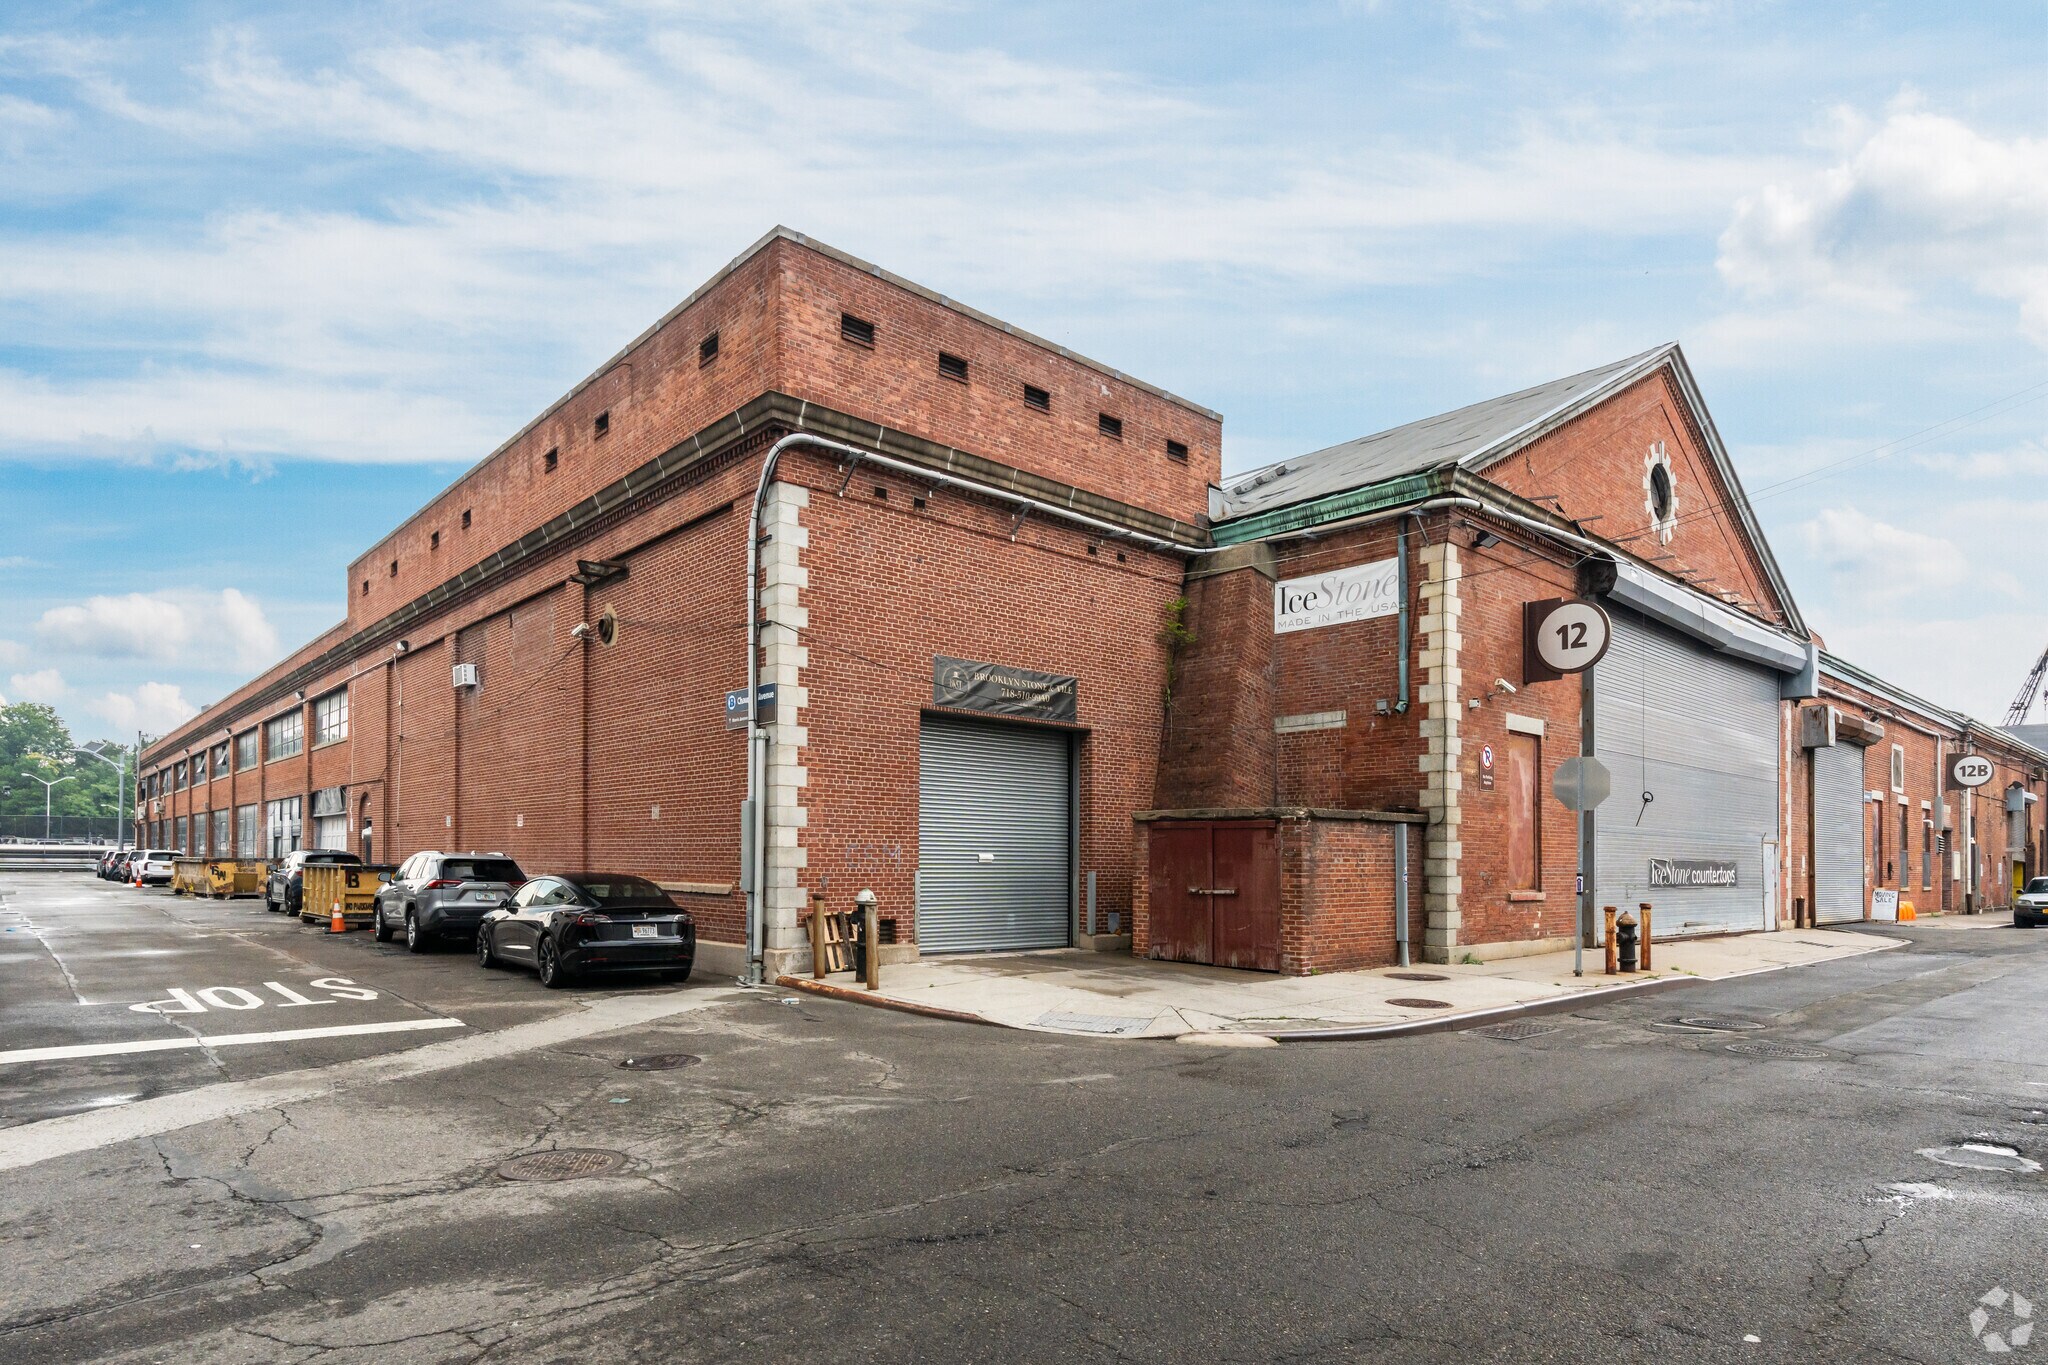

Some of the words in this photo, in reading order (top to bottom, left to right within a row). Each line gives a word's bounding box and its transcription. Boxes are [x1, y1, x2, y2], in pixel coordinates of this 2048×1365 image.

[1278, 574, 1398, 616] IceStone
[1278, 616, 1311, 630] MADE
[1318, 613, 1330, 623] IN
[1336, 607, 1363, 619] THE
[1371, 601, 1399, 613] USA
[1556, 622, 1587, 650] 12
[974, 672, 1020, 687] BROOKLYN
[1021, 680, 1048, 692] STONE
[1958, 764, 1989, 778] 12B
[1650, 858, 1690, 885] IceStone
[1691, 866, 1736, 887] countertops
[128, 977, 379, 1013] STOP
